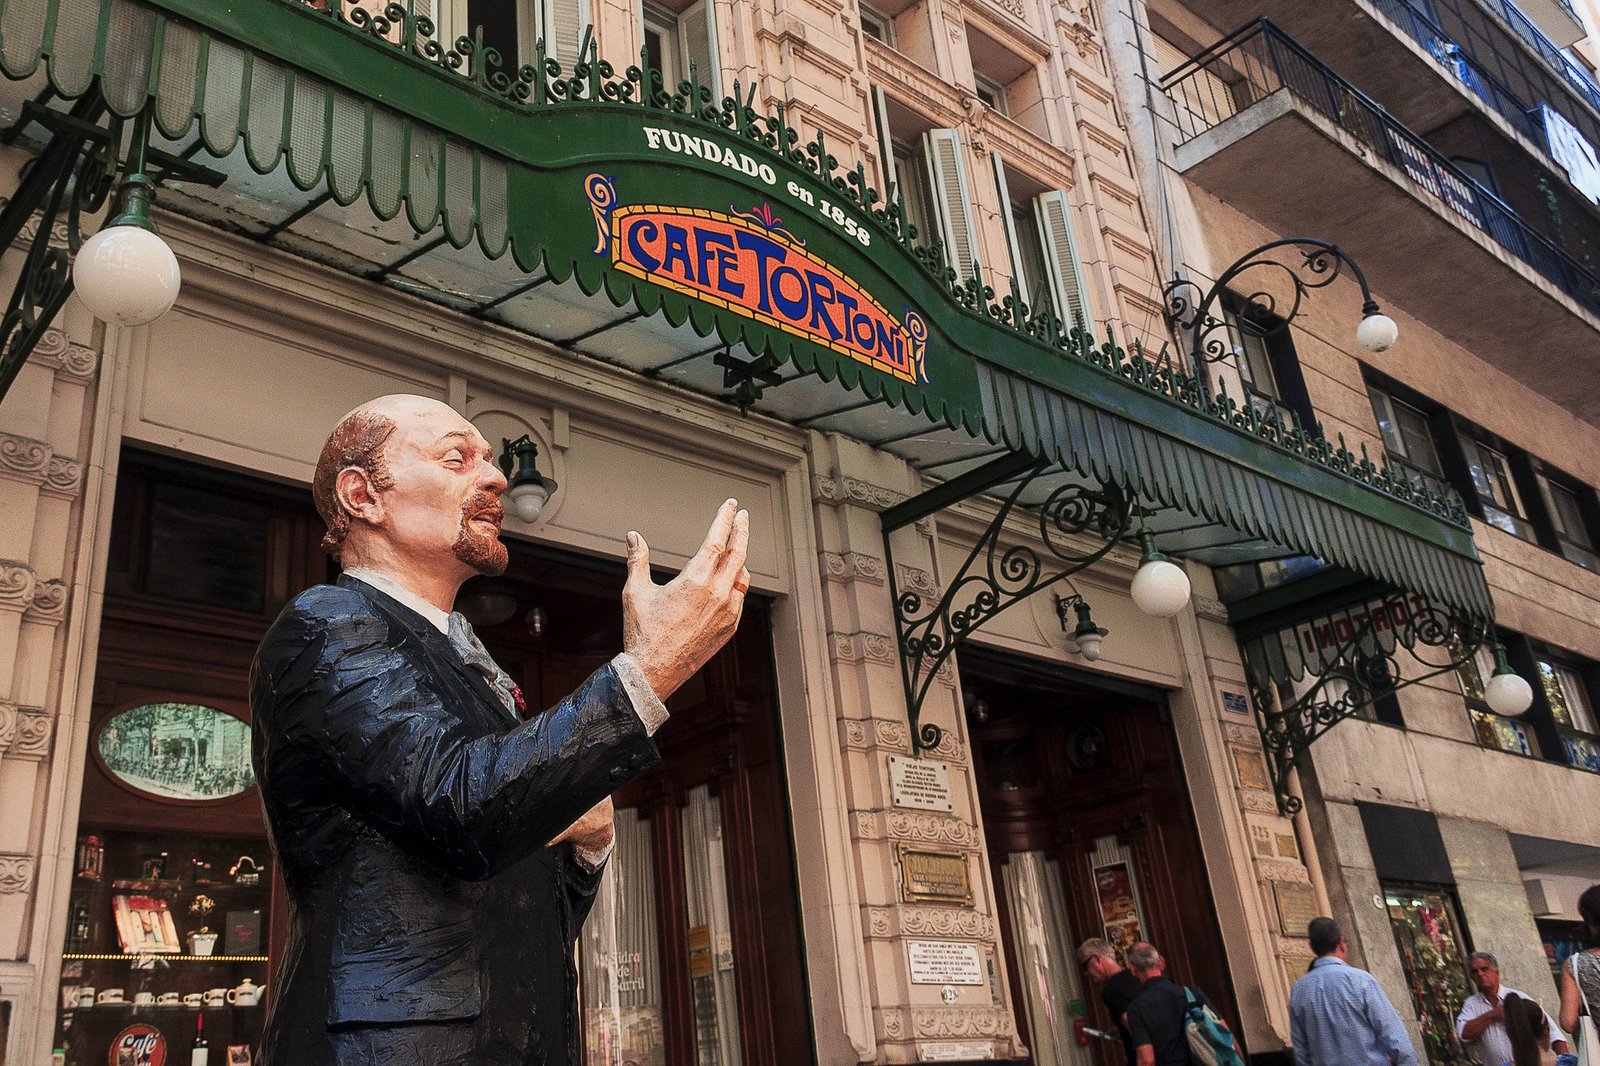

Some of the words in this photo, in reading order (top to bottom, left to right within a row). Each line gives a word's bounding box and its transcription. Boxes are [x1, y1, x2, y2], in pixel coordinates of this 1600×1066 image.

[643, 126, 776, 185] FUNDADO
[787, 180, 815, 207] en
[819, 195, 871, 247] 1858
[628, 220, 745, 299] CAFE
[735, 229, 904, 365] TORTONI
[617, 964, 630, 977] de
[119, 1032, 160, 1058] Café
